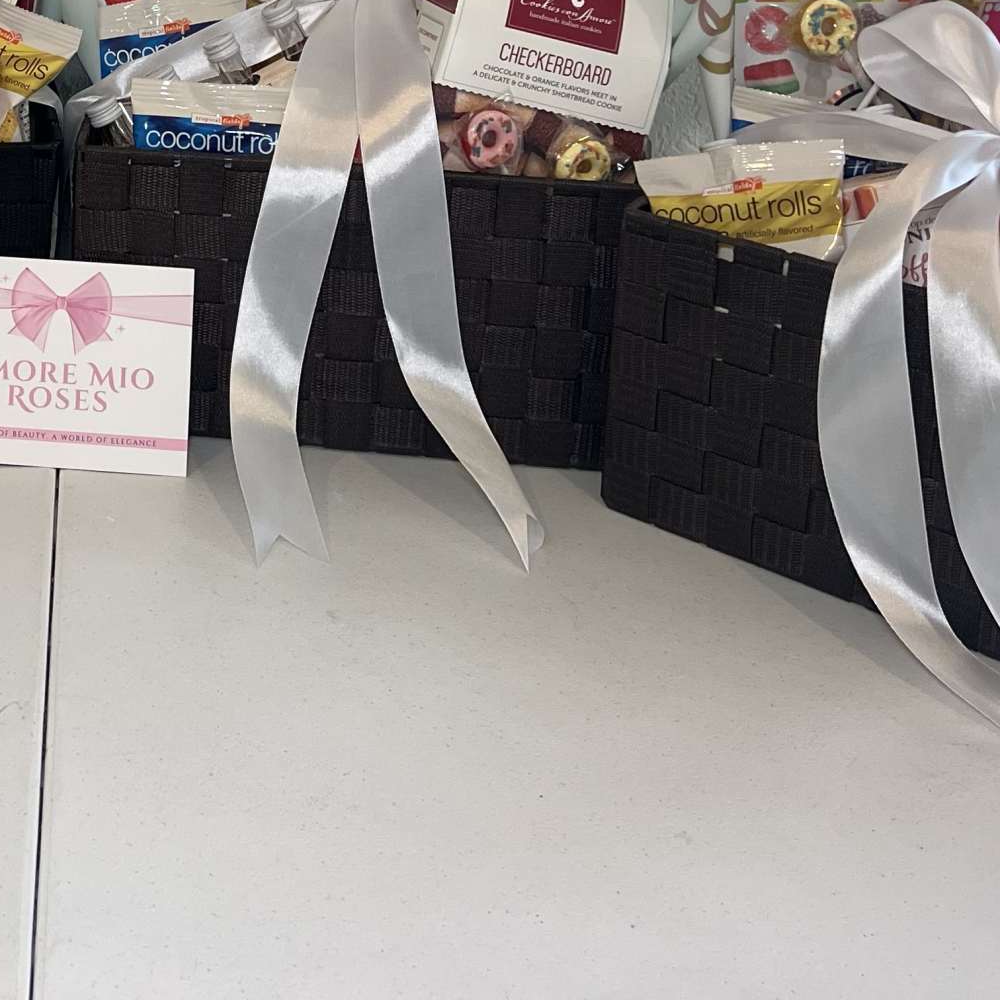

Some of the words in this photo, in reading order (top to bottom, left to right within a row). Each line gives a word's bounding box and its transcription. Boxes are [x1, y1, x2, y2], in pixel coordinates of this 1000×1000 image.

[6, 48, 49, 81] rolls
[499, 42, 612, 87] CHECKERBOARD
[480, 70, 510, 85] DELICATE
[517, 81, 551, 96] CRUNCHY
[551, 88, 596, 105] SHORTBREAD
[596, 99, 623, 112] COOKIE
[483, 64, 527, 80] CHOCOLATE
[532, 75, 560, 88] ORANGE
[561, 83, 590, 96] FLAVORS
[590, 90, 609, 100] MEET
[146, 129, 244, 154] coconut
[767, 190, 822, 219] rolls
[88, 362, 155, 393] MIO
[8, 384, 108, 413] ROSES
[61, 434, 94, 444] WORLD
[110, 437, 158, 447] ELEGANCE
